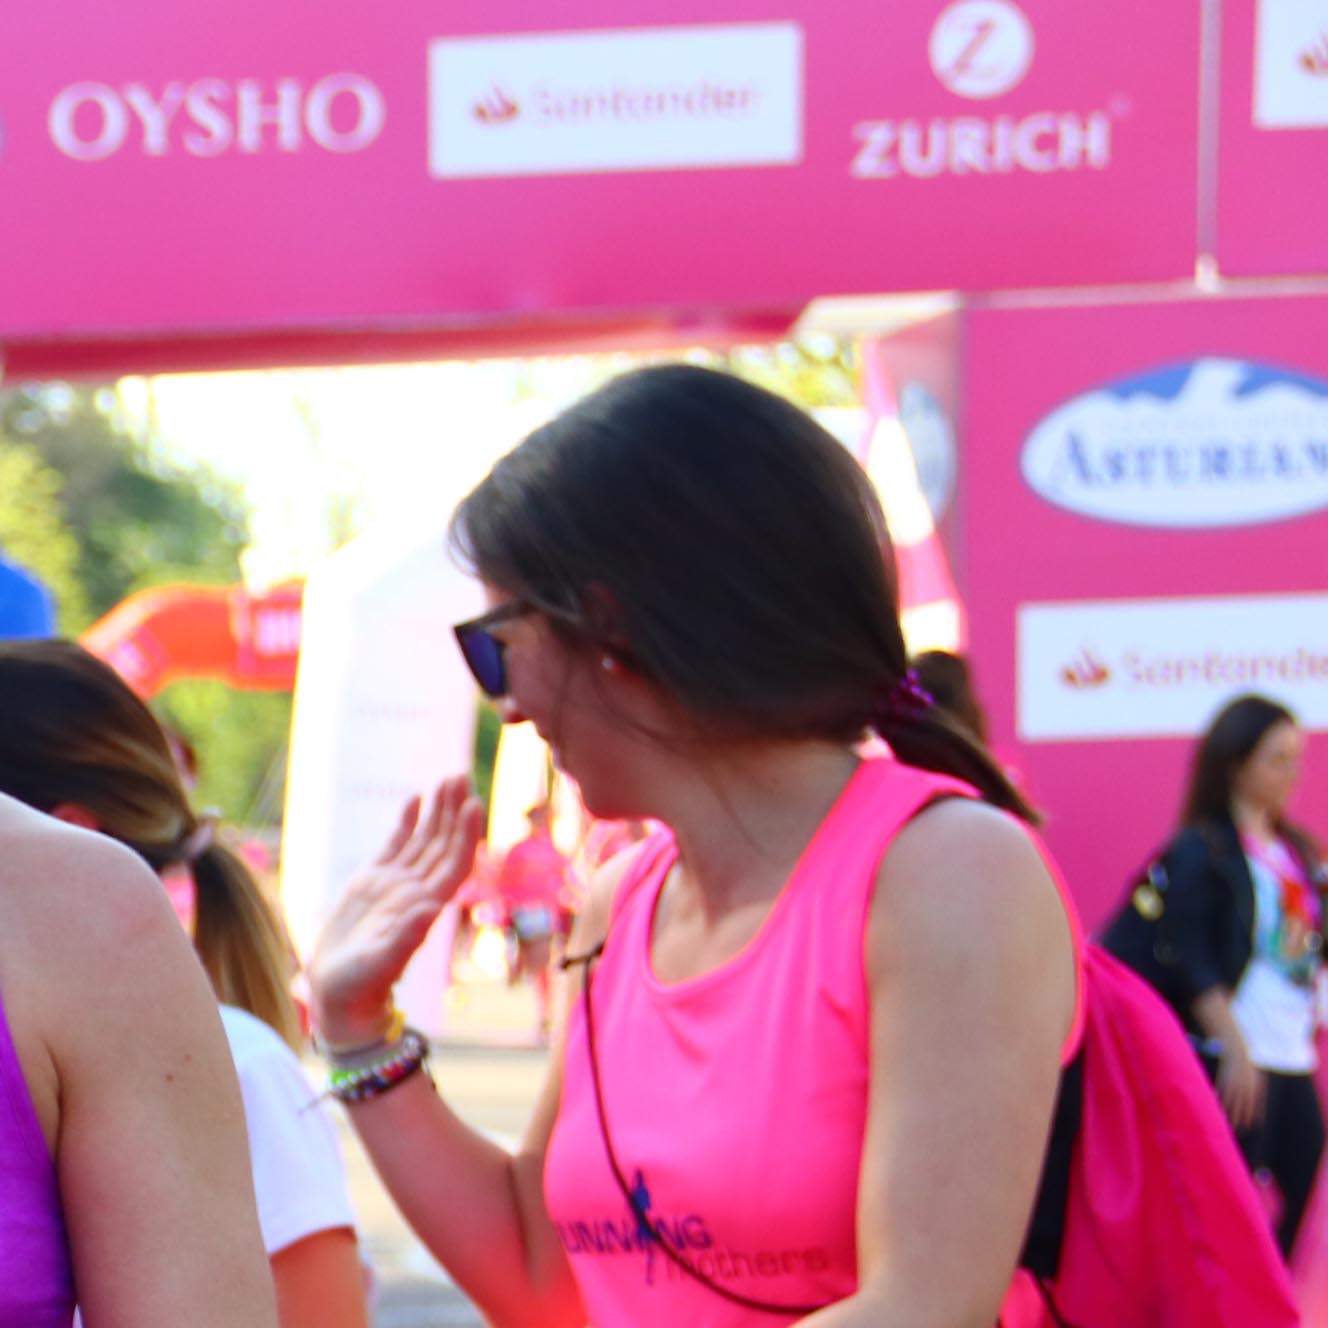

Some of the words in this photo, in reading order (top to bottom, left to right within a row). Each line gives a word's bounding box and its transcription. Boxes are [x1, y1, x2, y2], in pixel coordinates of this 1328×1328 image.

[48, 71, 386, 162] OYSHO
[850, 111, 1111, 179] ZURICH
[1047, 432, 1328, 486] ASTURIAN
